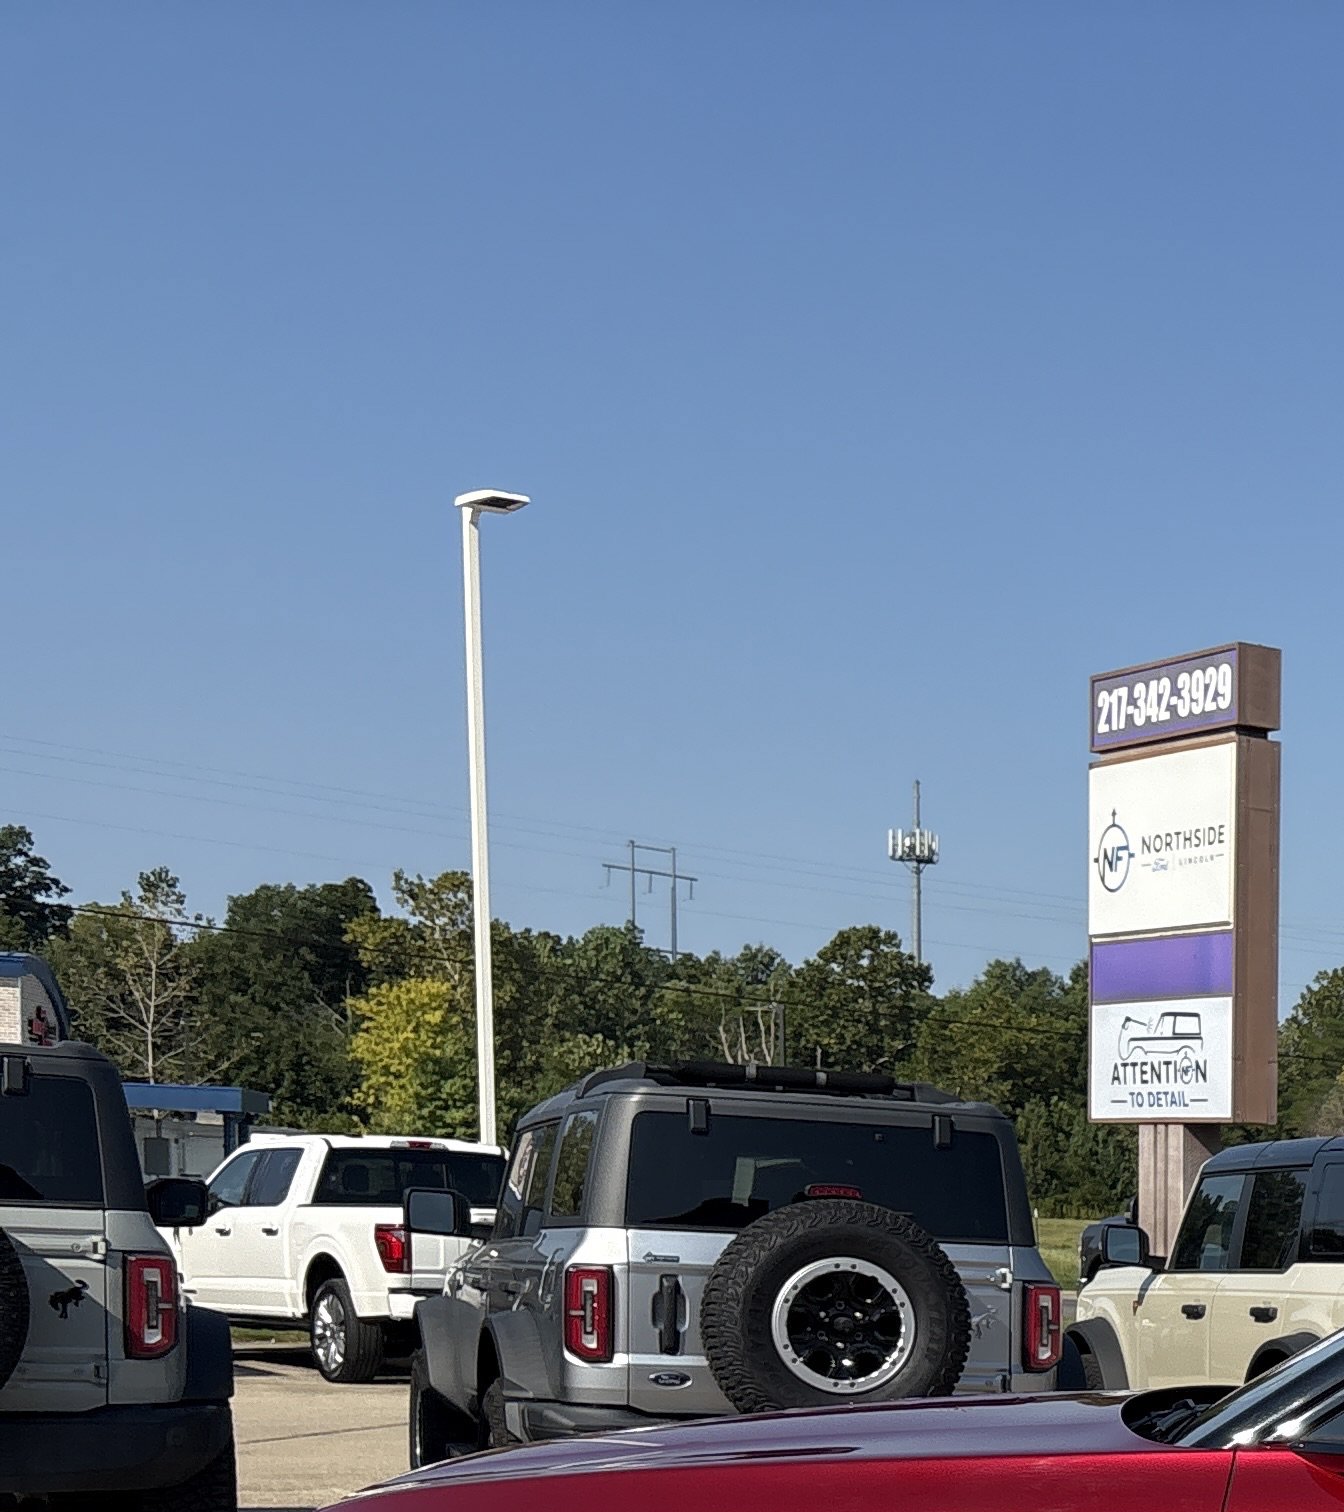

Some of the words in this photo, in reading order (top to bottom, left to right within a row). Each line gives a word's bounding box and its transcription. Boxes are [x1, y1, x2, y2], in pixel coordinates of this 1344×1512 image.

[1097, 663, 1232, 733] 217-342-3929
[1141, 824, 1225, 855] NORTHSIDE
[1103, 845, 1129, 874] NF
[1111, 1059, 1207, 1085] ATTENTION
[1129, 1092, 1144, 1108] TO
[1147, 1091, 1189, 1107] DETAIL
